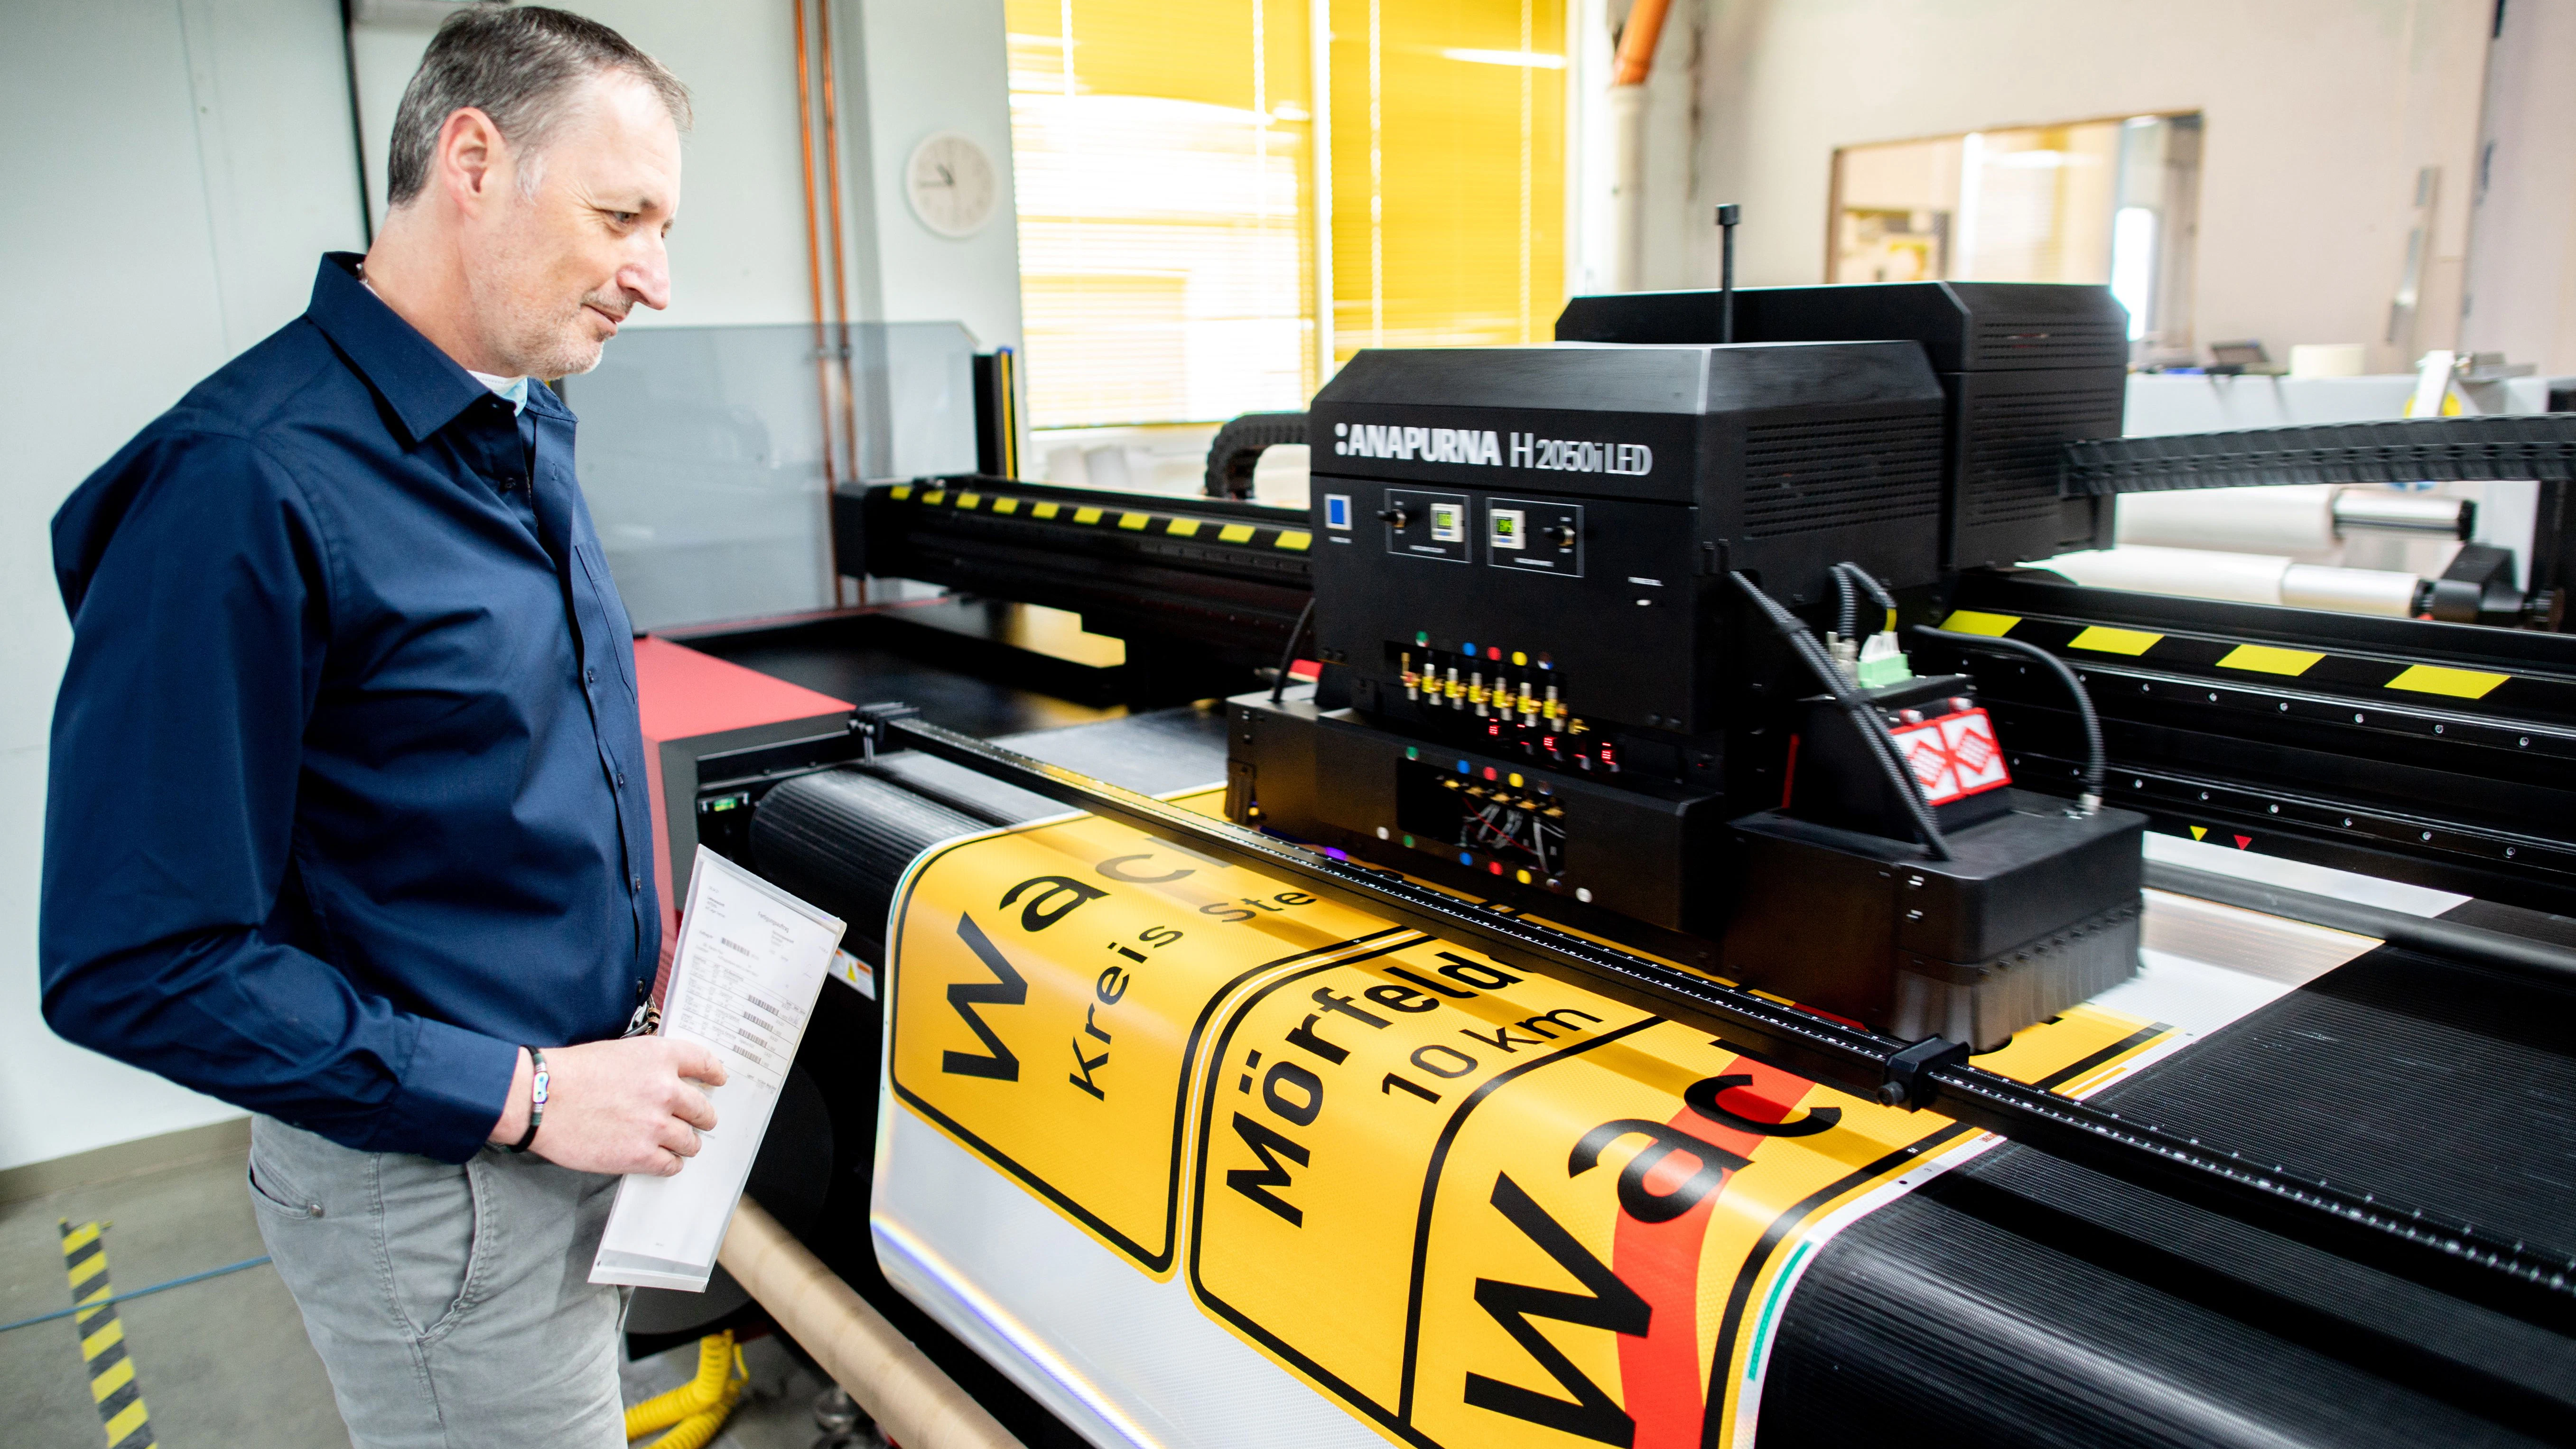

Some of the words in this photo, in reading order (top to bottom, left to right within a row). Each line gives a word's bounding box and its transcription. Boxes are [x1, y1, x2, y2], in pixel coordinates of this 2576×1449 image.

[942, 836, 1235, 1082] Wac
[1069, 925, 1184, 1101] Kreis
[1382, 1045, 1479, 1105] 10
[1459, 1009, 1605, 1053] km
[1227, 951, 1537, 1229] Mörfeld
[1464, 1038, 1880, 1449] Wac
